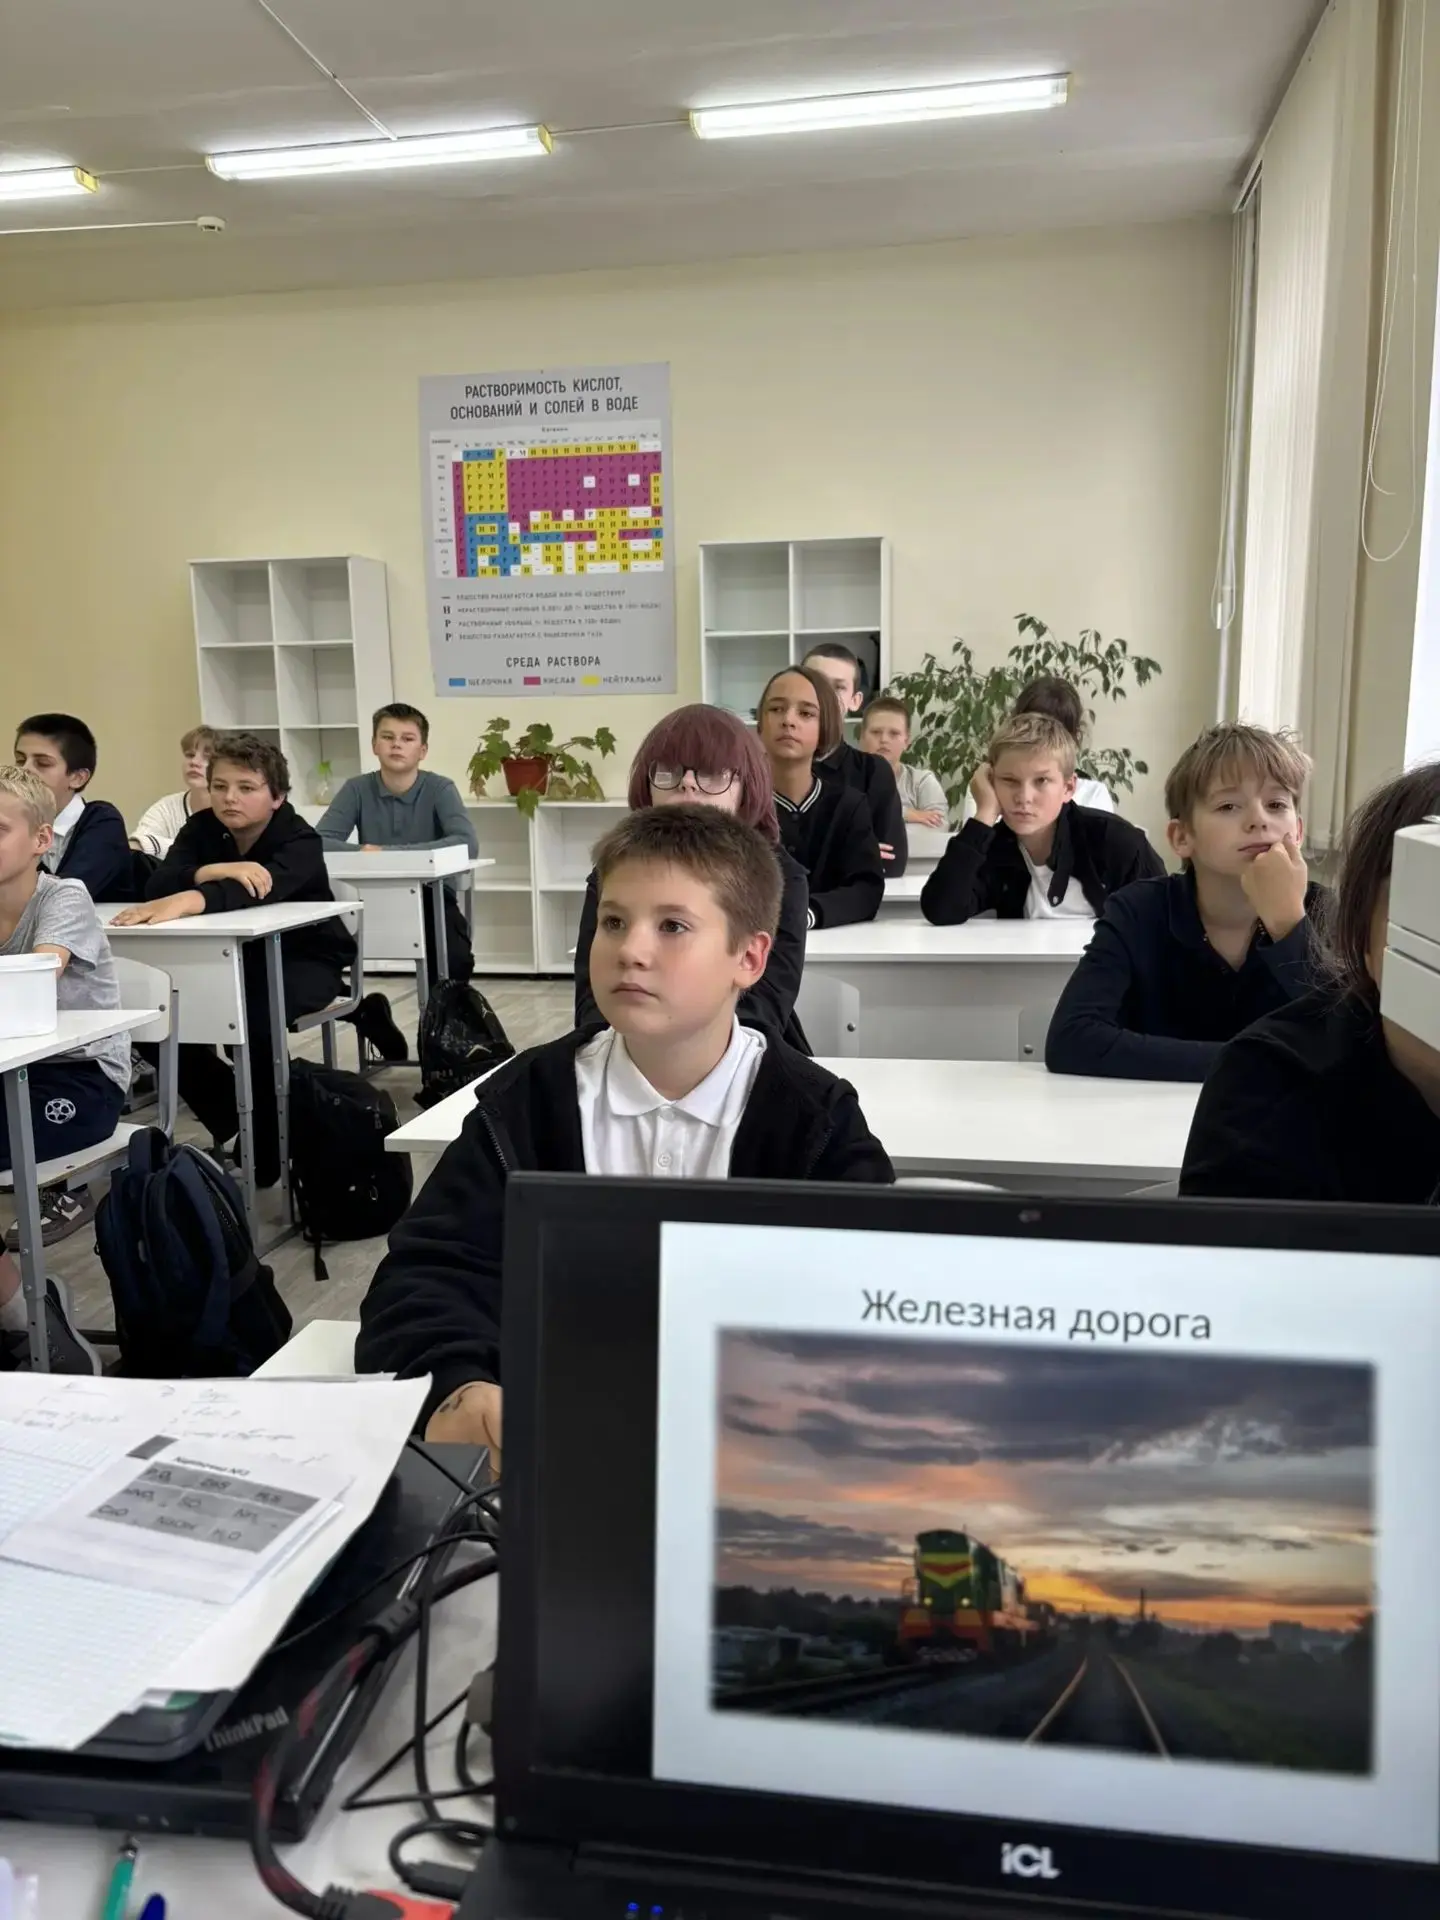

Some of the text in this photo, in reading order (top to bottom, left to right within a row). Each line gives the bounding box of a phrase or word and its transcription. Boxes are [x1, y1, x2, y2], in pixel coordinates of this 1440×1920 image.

[465, 376, 623, 399] РАСТВОРИМОСТЬ КИСЛОТ,
[450, 396, 639, 420] ОСНОВАНИЙ И СОЛЕЙ В ВОДЕ
[506, 656, 601, 668] СРЕДА РАСТВОРА
[603, 674, 662, 683] НЕЙТРАЛЬНАЯ
[861, 1289, 1212, 1342] Железная дорога
[204, 1705, 290, 1753] ThinkPad
